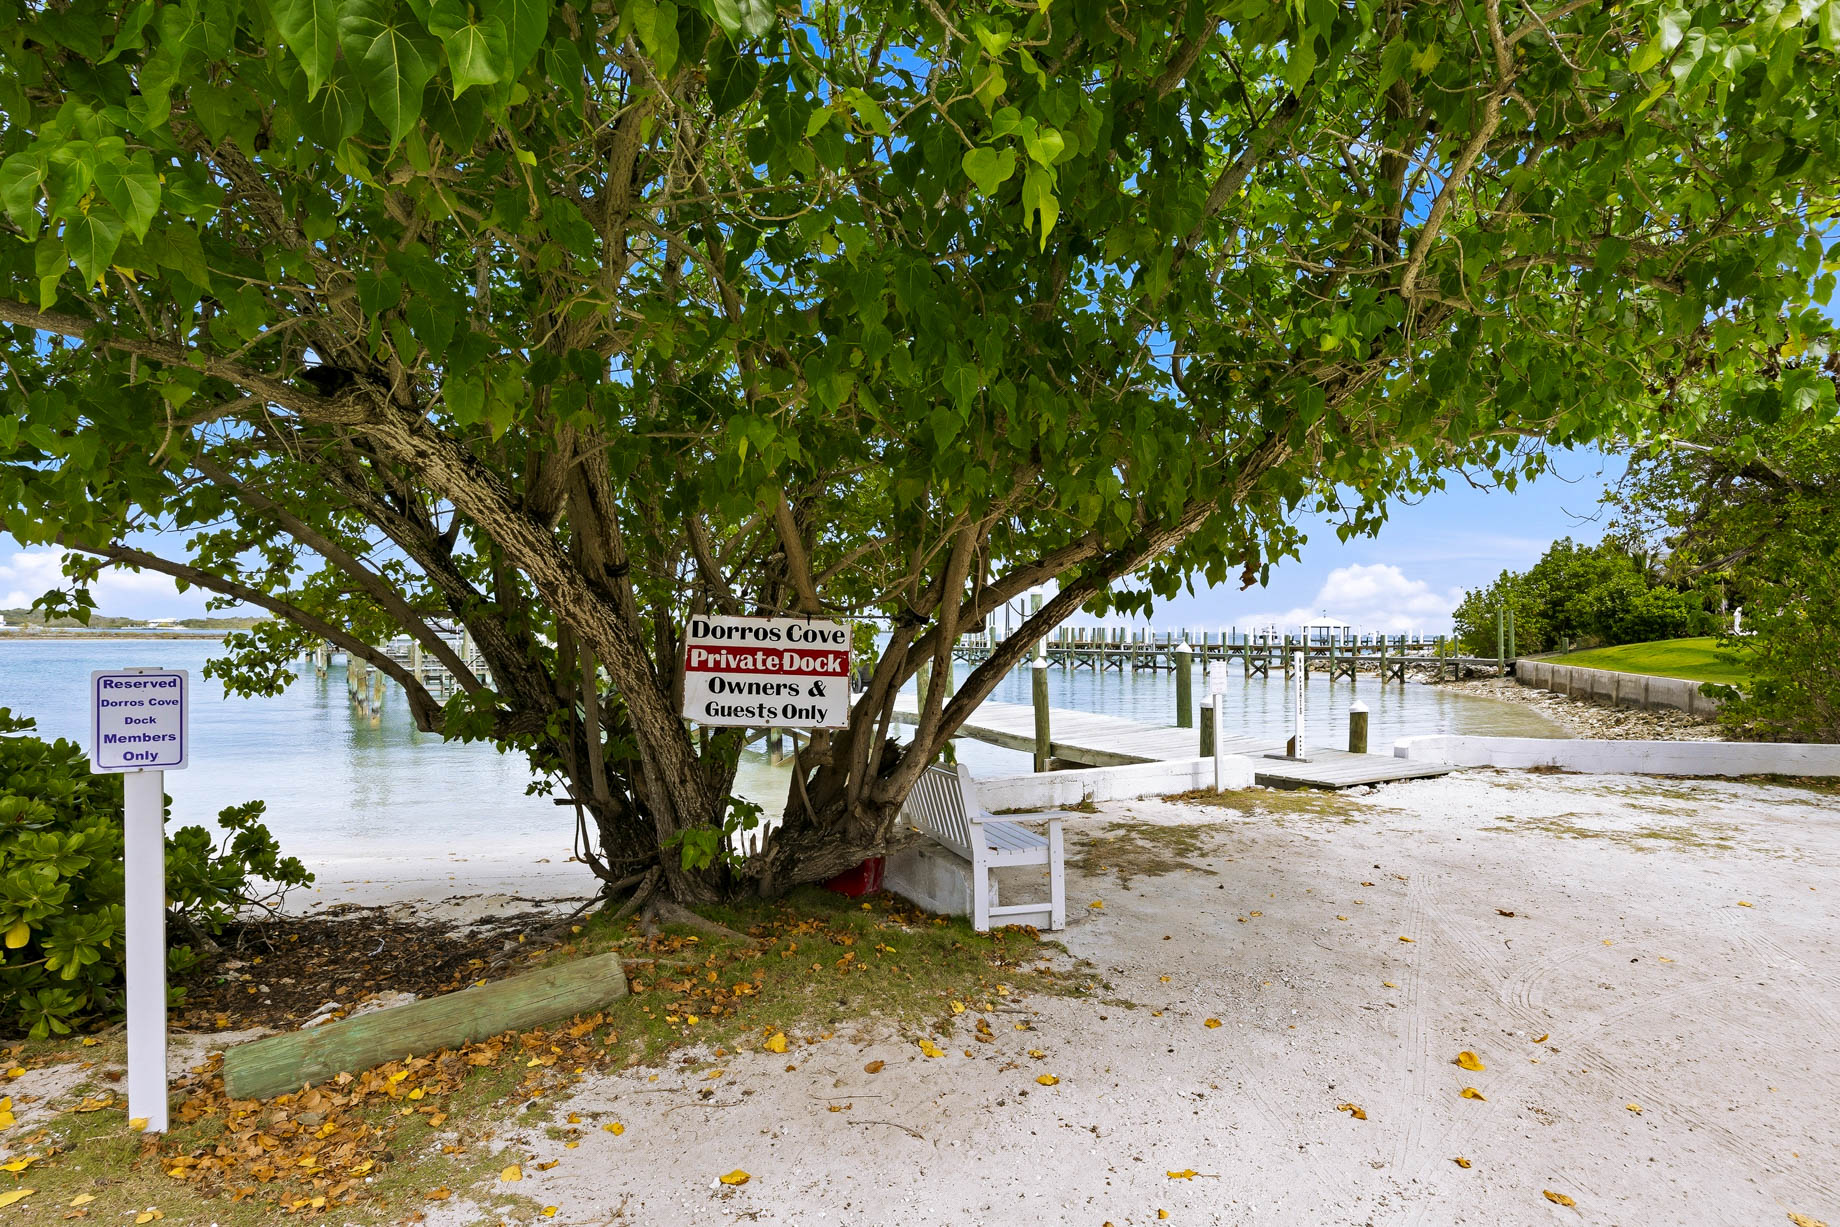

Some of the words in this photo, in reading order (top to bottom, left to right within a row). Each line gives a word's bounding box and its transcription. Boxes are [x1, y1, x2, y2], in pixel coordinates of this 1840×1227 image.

[692, 620, 781, 642] Dorros
[786, 624, 845, 644] Cove
[690, 648, 780, 671] Private
[783, 652, 842, 673] Dock
[103, 678, 177, 689] Reserved
[708, 676, 800, 697] Owners
[808, 680, 827, 698] &
[101, 698, 145, 708] Dorros
[148, 698, 179, 706] Cove
[705, 701, 778, 719] Guests
[782, 703, 828, 724] Only
[124, 716, 157, 725] Dock
[103, 733, 176, 744] Members
[122, 750, 159, 762] Only
